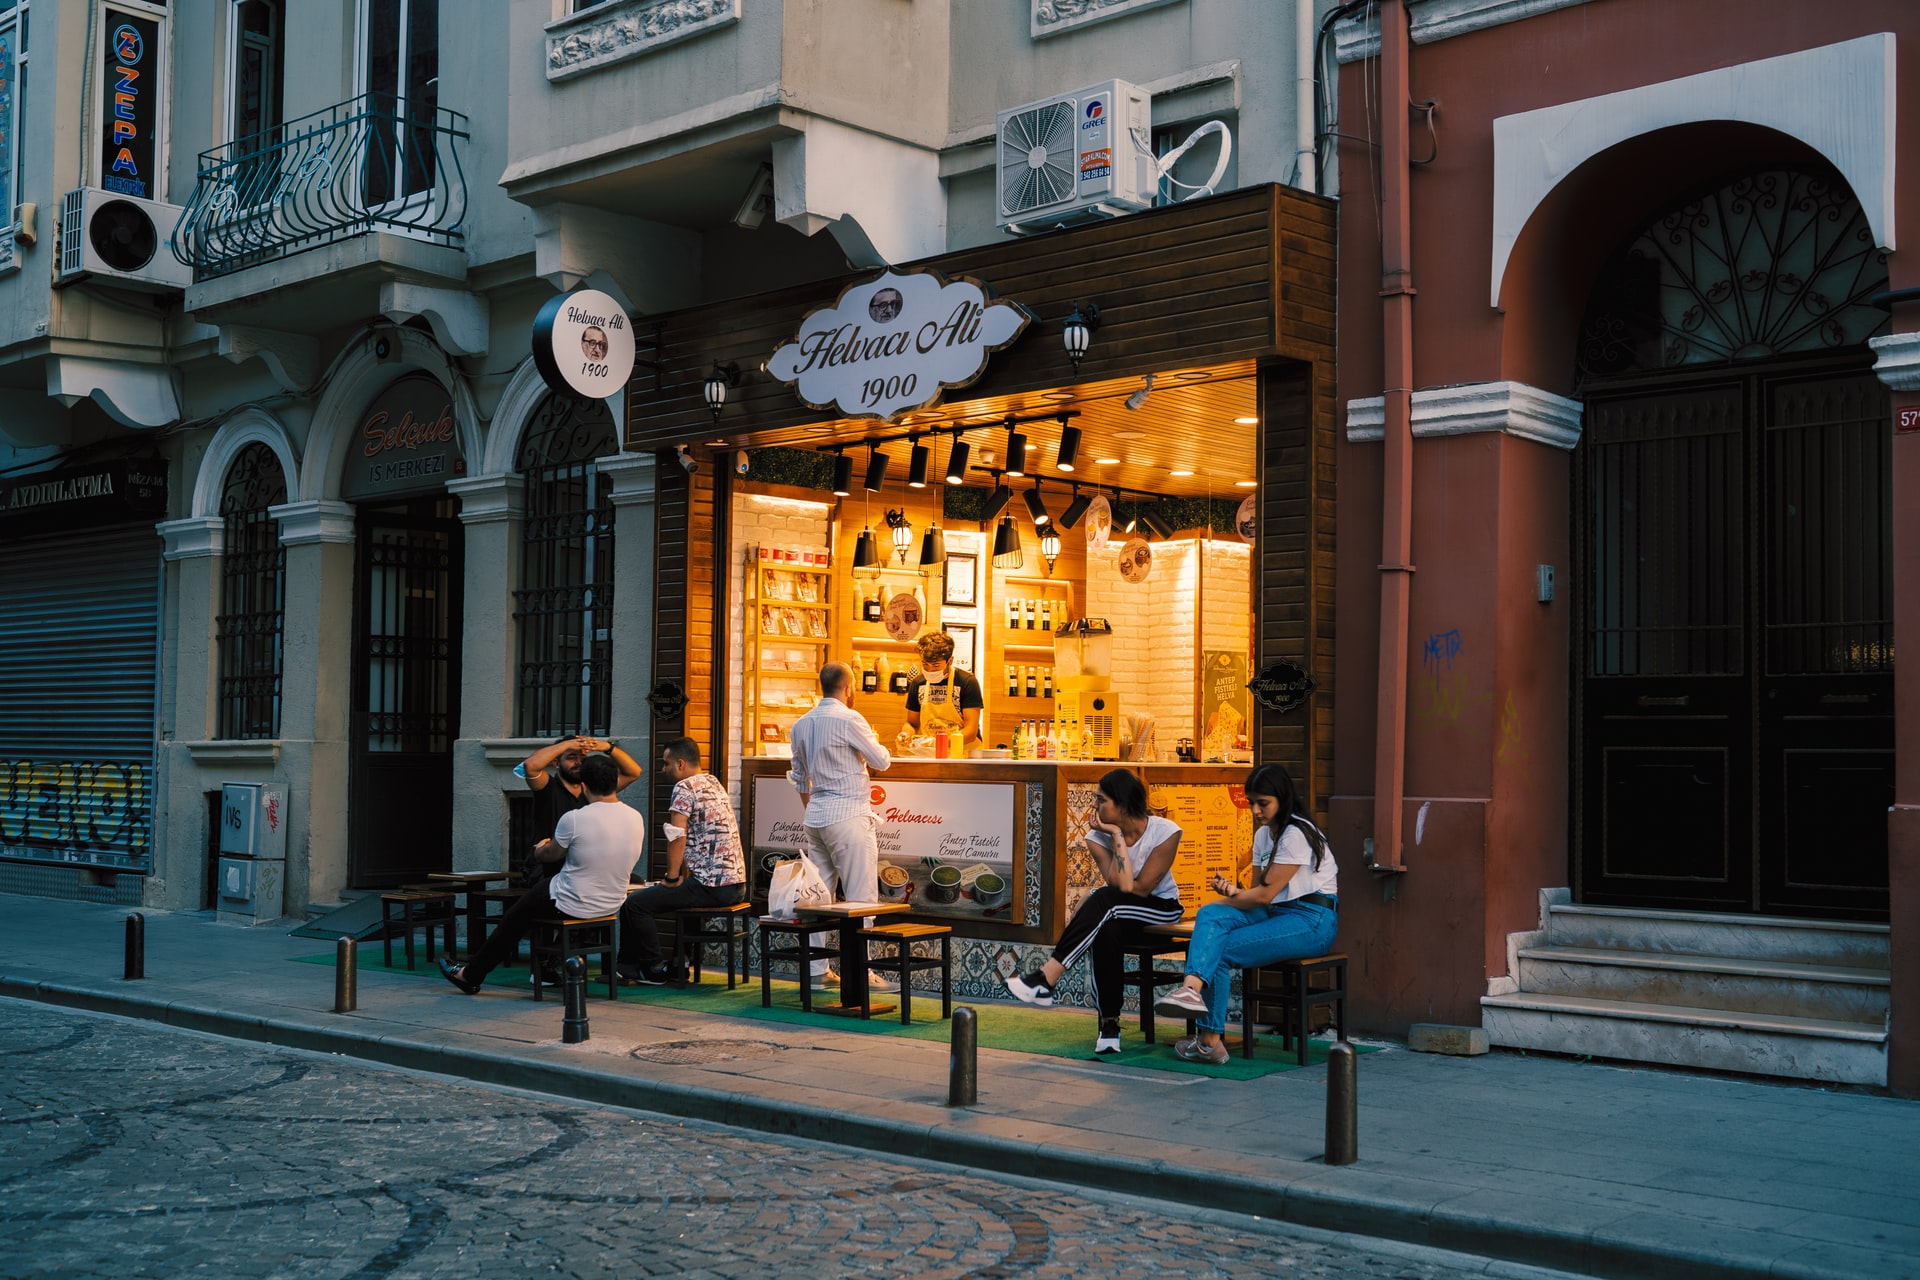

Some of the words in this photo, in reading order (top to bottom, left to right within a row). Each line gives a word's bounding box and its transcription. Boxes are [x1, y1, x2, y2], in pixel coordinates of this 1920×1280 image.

[112, 65, 140, 176] ZEPA
[1082, 116, 1107, 130] GREE
[609, 313, 625, 330] Ali
[792, 323, 911, 374] Helvacı
[916, 300, 985, 354] Ali
[581, 362, 609, 378] 1900
[860, 373, 918, 408] 1900
[363, 404, 454, 457] Selçuk
[9, 472, 114, 510] AYDINLATMA
[1216, 676, 1236, 686] ANTEP
[1217, 692, 1236, 701] HELVA
[886, 807, 943, 824] Helvacısı
[939, 832, 967, 848] Antep
